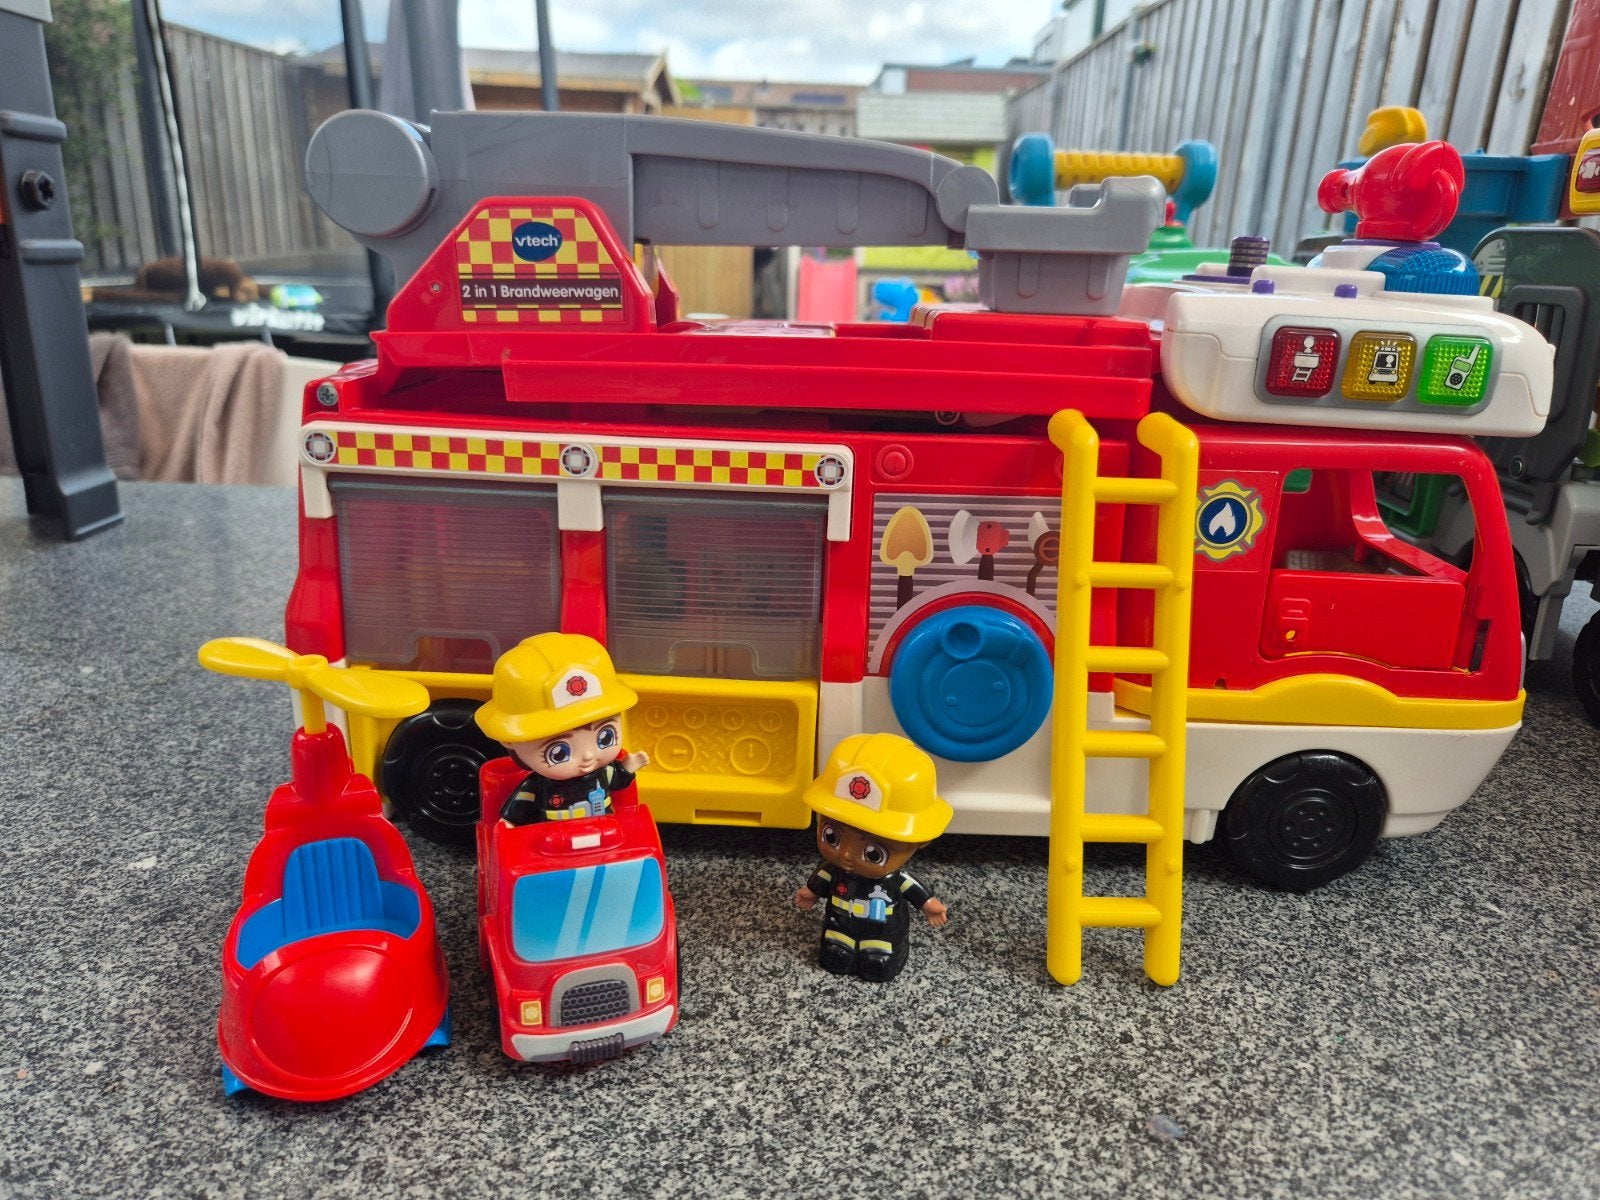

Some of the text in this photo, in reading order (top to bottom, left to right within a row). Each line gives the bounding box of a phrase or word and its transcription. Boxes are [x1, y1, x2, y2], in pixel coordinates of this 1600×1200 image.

[515, 235, 558, 247] vtech
[462, 285, 618, 300] 2 in 1 Brandweerwagen
